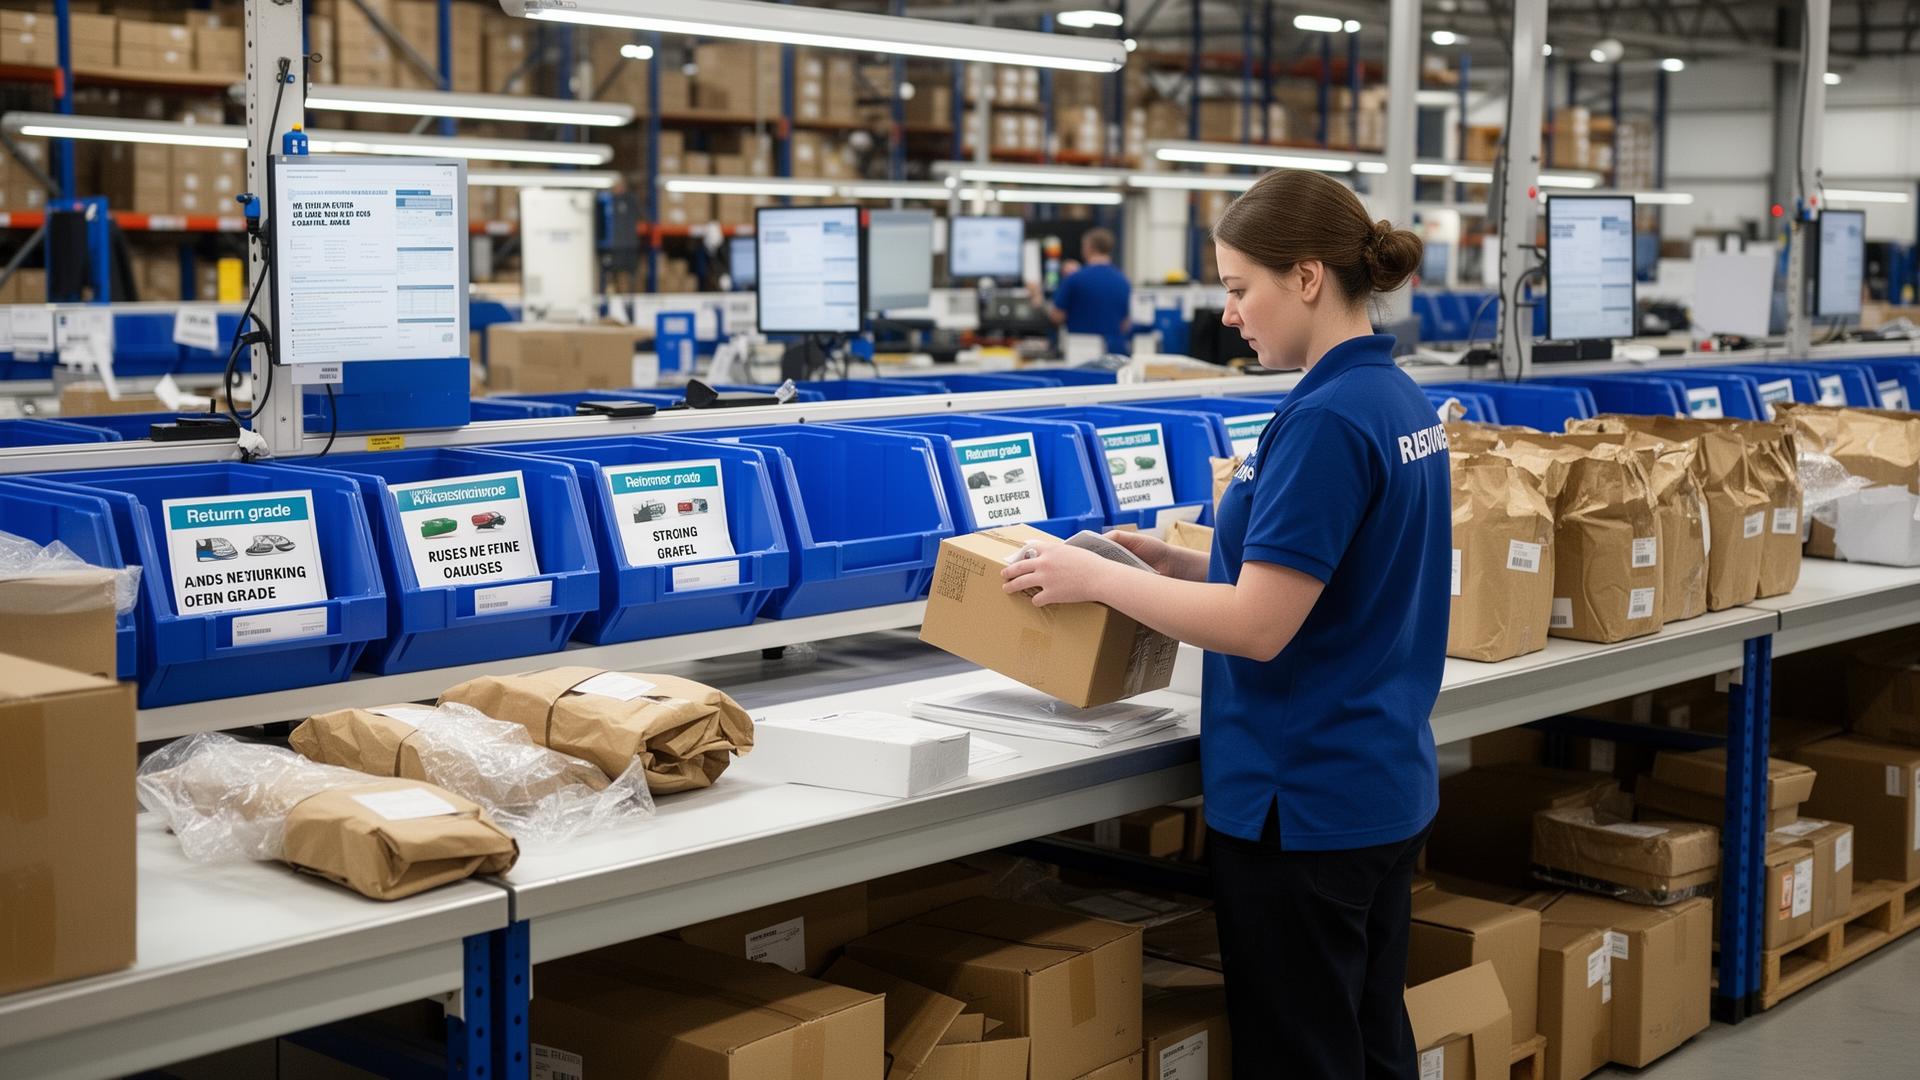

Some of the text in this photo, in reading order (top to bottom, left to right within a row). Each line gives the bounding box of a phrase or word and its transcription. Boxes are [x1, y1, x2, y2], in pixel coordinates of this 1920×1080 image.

[248, 504, 291, 520] grade
[428, 547, 467, 562] RUSES
[657, 544, 697, 559] GRAFEL
[227, 587, 276, 602] GRADE
